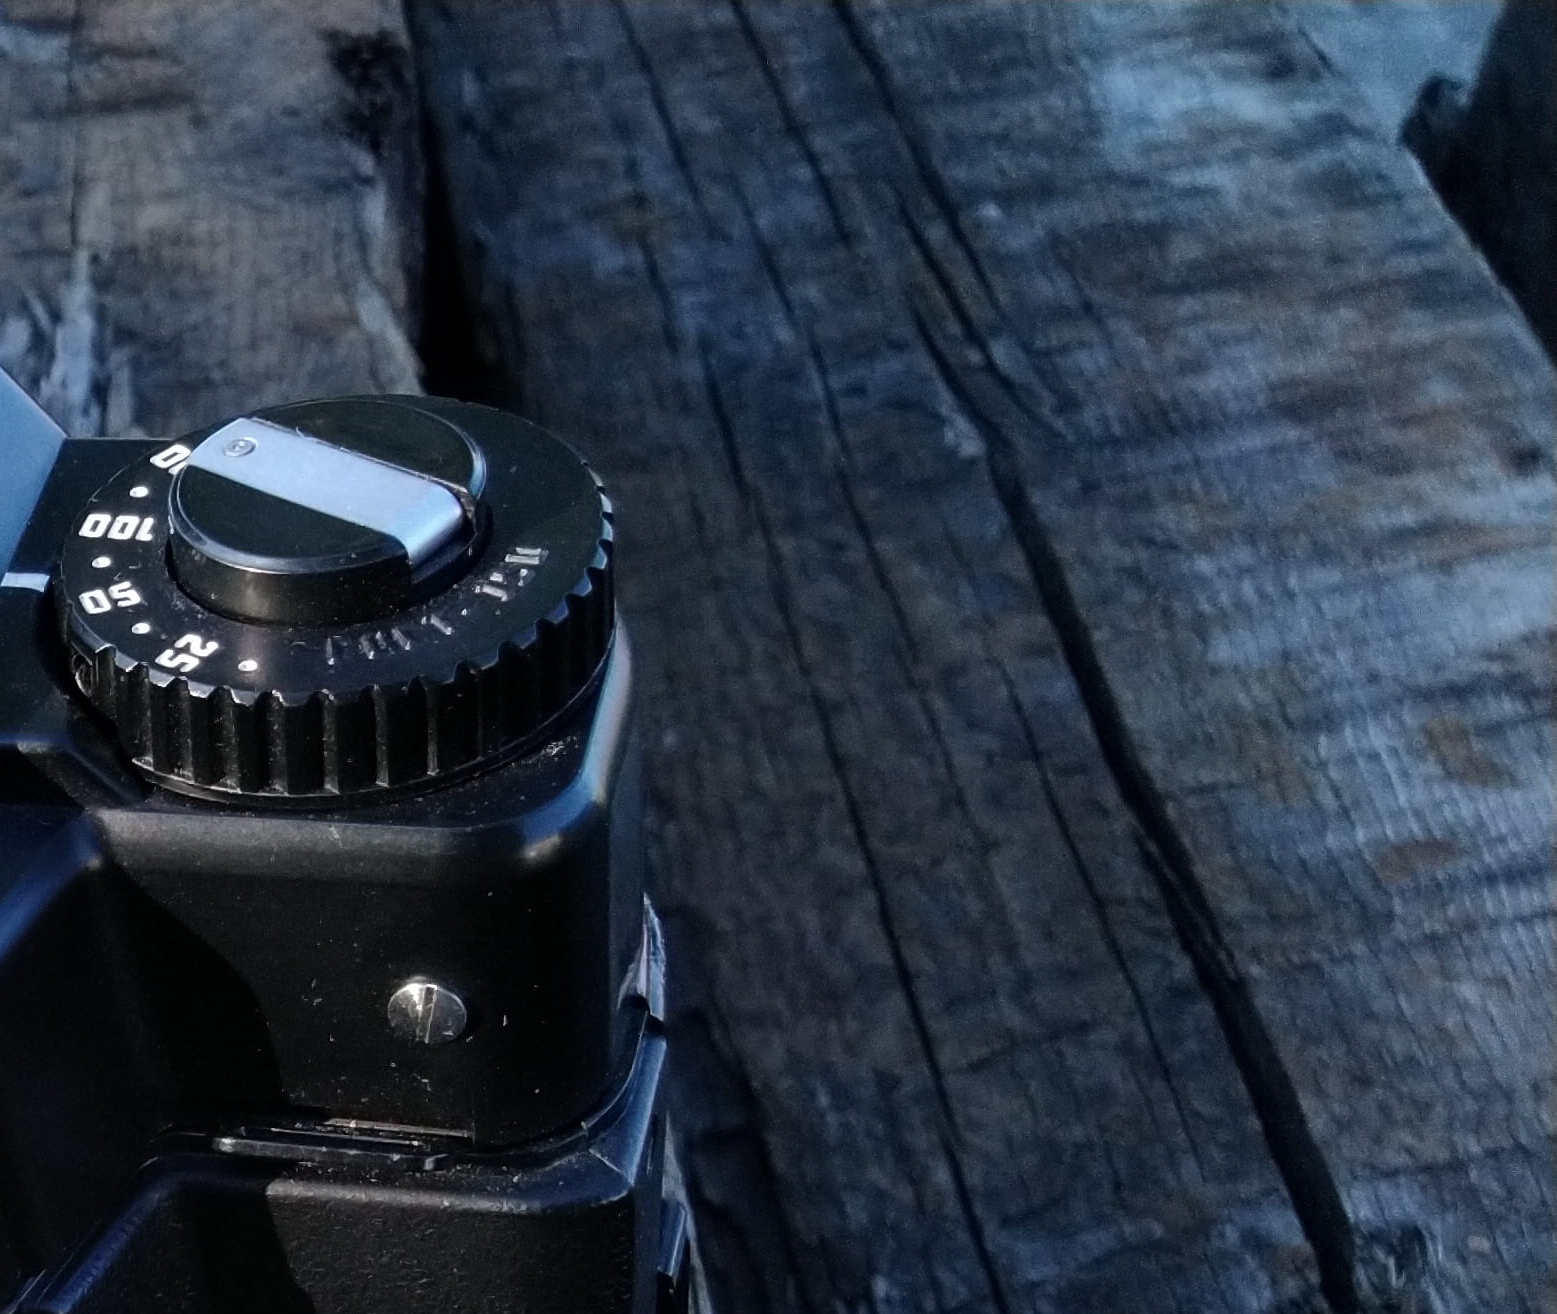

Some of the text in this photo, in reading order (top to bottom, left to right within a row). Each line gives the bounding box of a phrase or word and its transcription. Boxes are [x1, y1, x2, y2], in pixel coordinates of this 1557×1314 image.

[77, 512, 156, 543] 100
[77, 579, 143, 616] 50
[154, 632, 220, 674] 25
